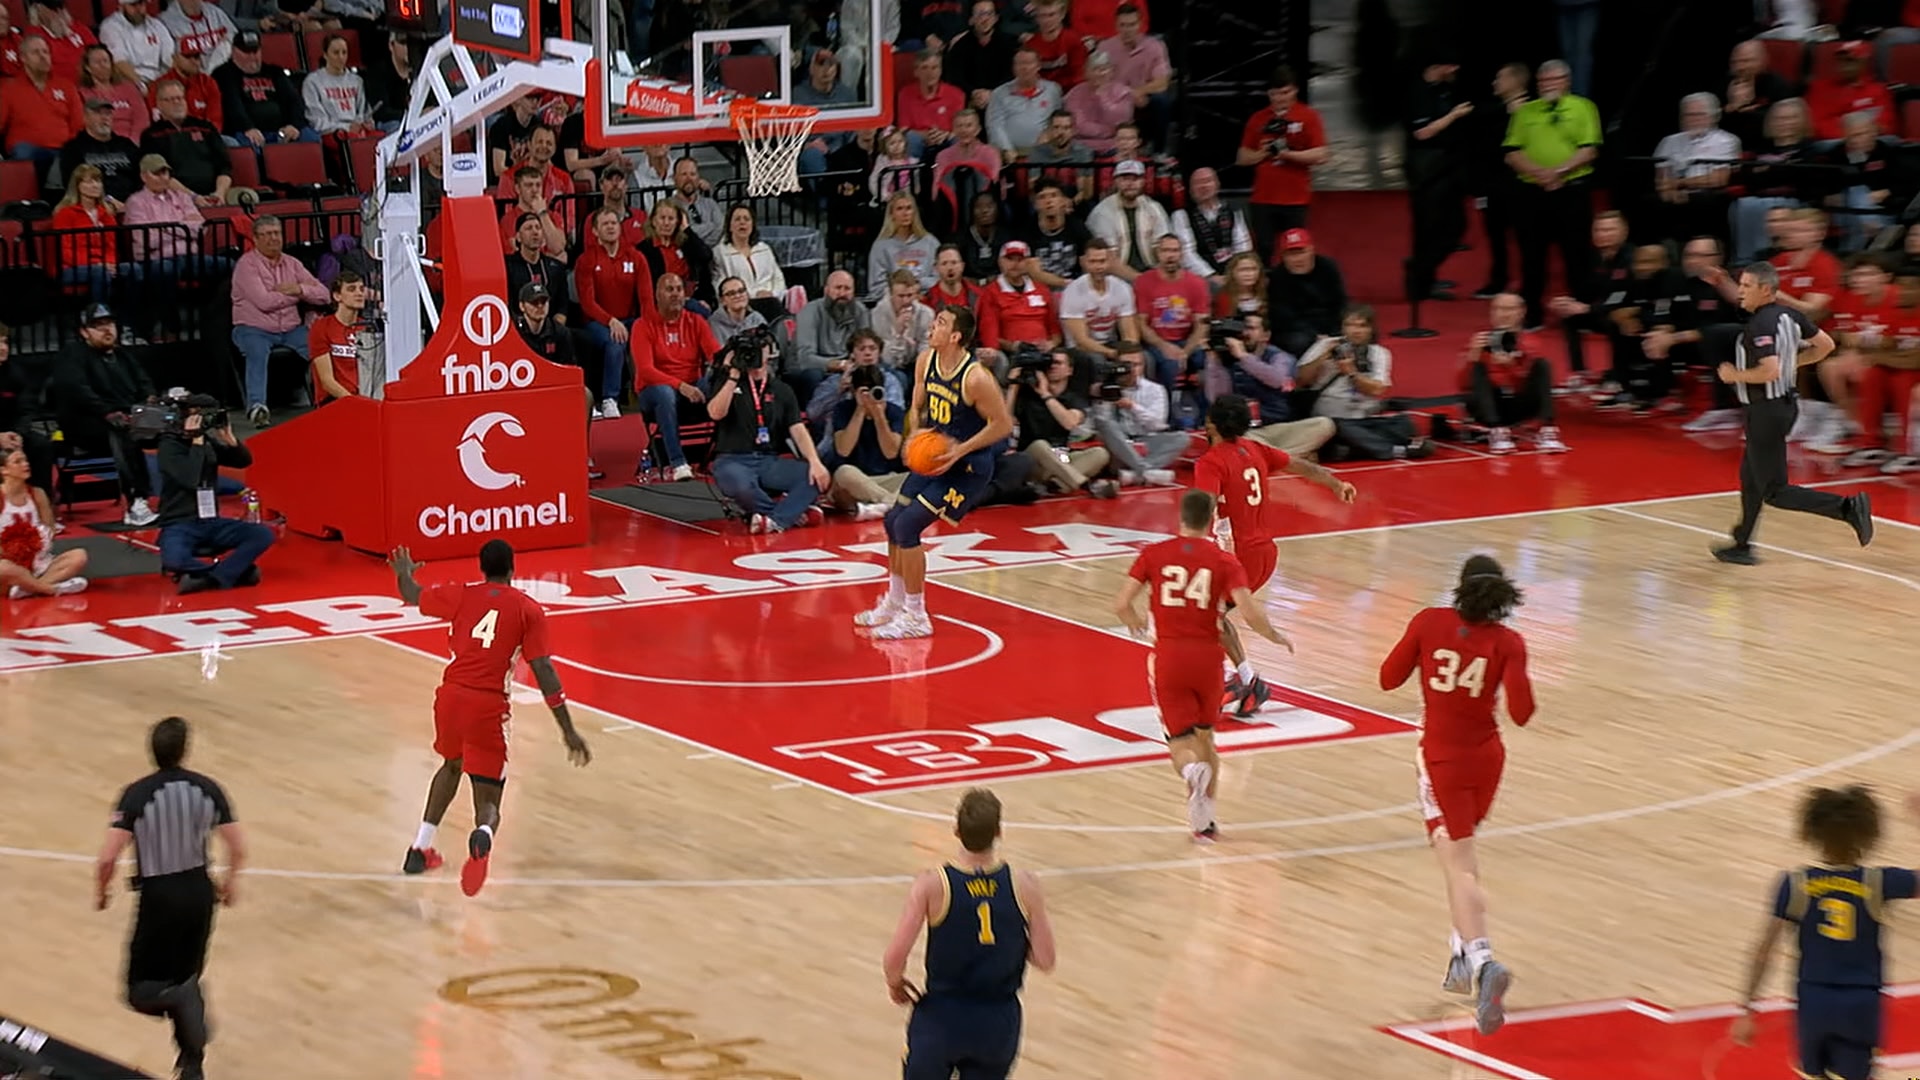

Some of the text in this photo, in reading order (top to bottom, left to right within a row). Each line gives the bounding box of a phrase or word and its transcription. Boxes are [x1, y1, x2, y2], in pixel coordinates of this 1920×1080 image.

[441, 351, 535, 395] fnbo
[929, 394, 952, 425] 50
[1243, 467, 1262, 506] 3
[418, 492, 568, 538] Channel
[1160, 564, 1212, 610] 24
[471, 608, 499, 649] 4
[1428, 648, 1488, 698] 34
[976, 901, 995, 945] 1
[1816, 898, 1857, 941] 3
